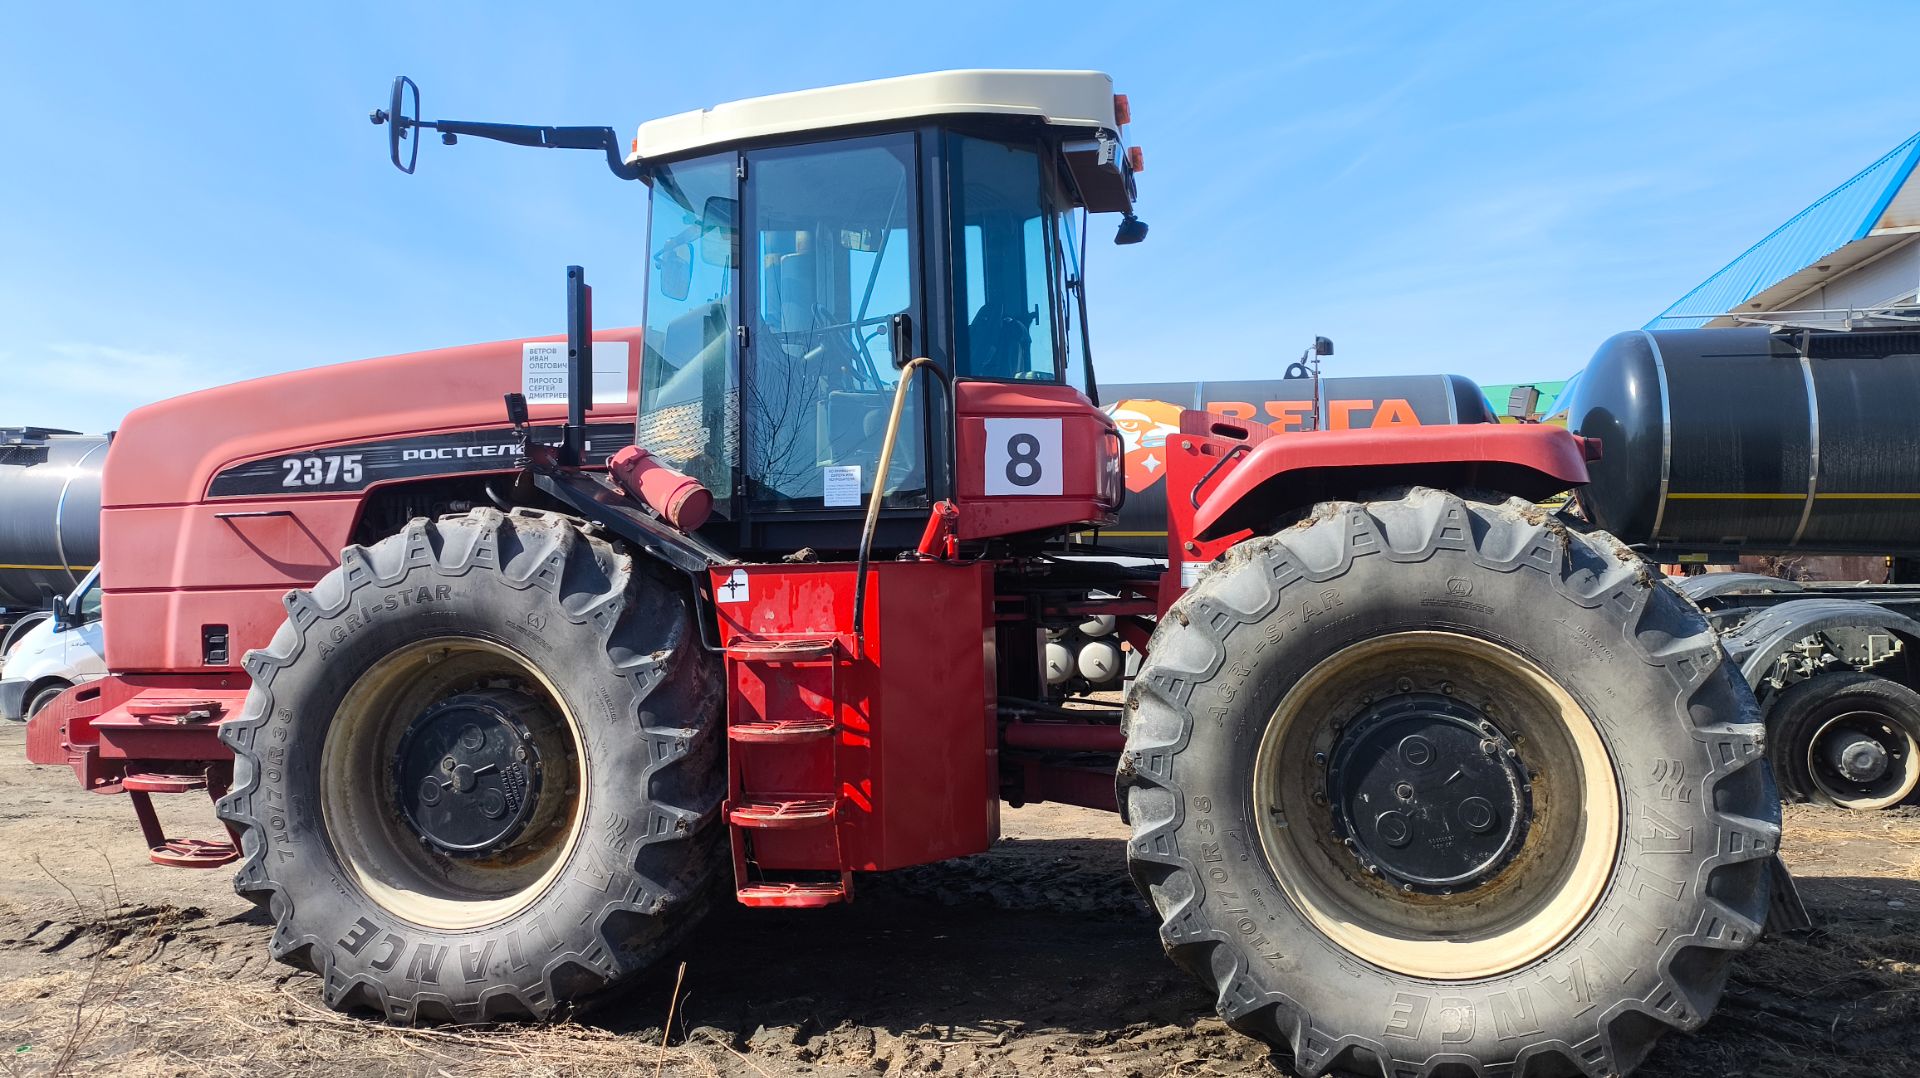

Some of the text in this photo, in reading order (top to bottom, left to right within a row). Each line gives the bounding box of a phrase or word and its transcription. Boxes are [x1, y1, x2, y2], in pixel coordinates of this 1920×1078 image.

[528, 384, 556, 392] СЕРГЕЙ
[528, 392, 569, 400] ДМИТРИЕВ
[282, 453, 363, 487] 2375
[402, 440, 592, 461] РОСТСЕЛЬ
[1005, 433, 1042, 487] 8
[316, 584, 452, 661] AGRI-STAR
[1207, 588, 1344, 728] AGRI-STAR
[337, 840, 616, 986] ALLIANCE
[1382, 803, 1695, 1045] ALLIANCE
